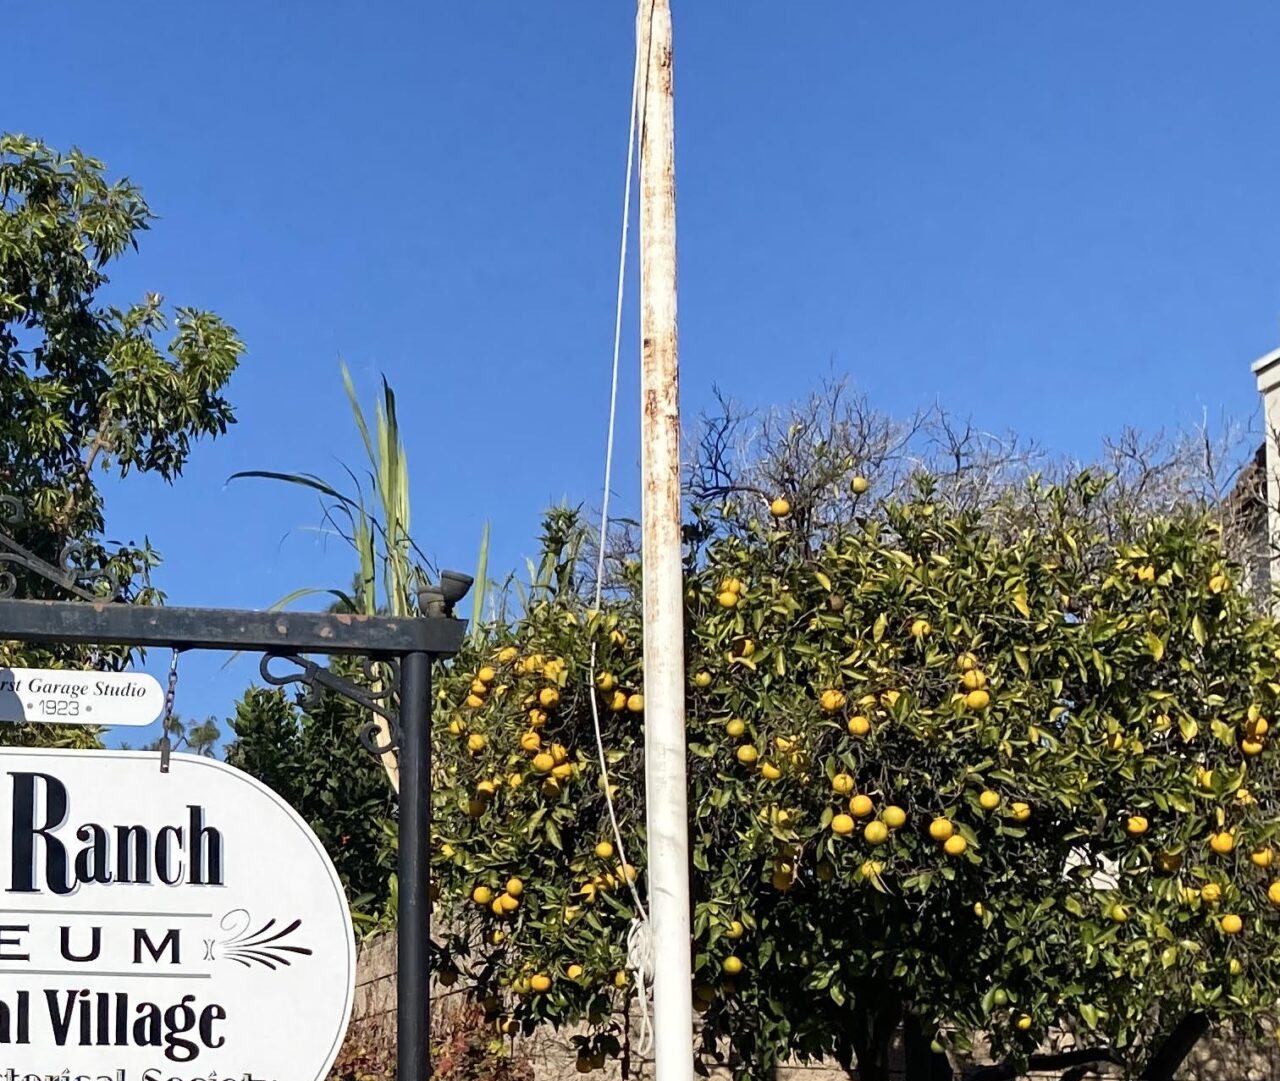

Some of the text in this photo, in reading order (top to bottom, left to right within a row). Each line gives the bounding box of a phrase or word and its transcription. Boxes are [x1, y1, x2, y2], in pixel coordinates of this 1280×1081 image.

[28, 677, 89, 698] Garage
[93, 680, 147, 698] Studio
[38, 699, 80, 716] 1923
[5, 770, 224, 897] Ranch
[44, 989, 227, 1062] Village
